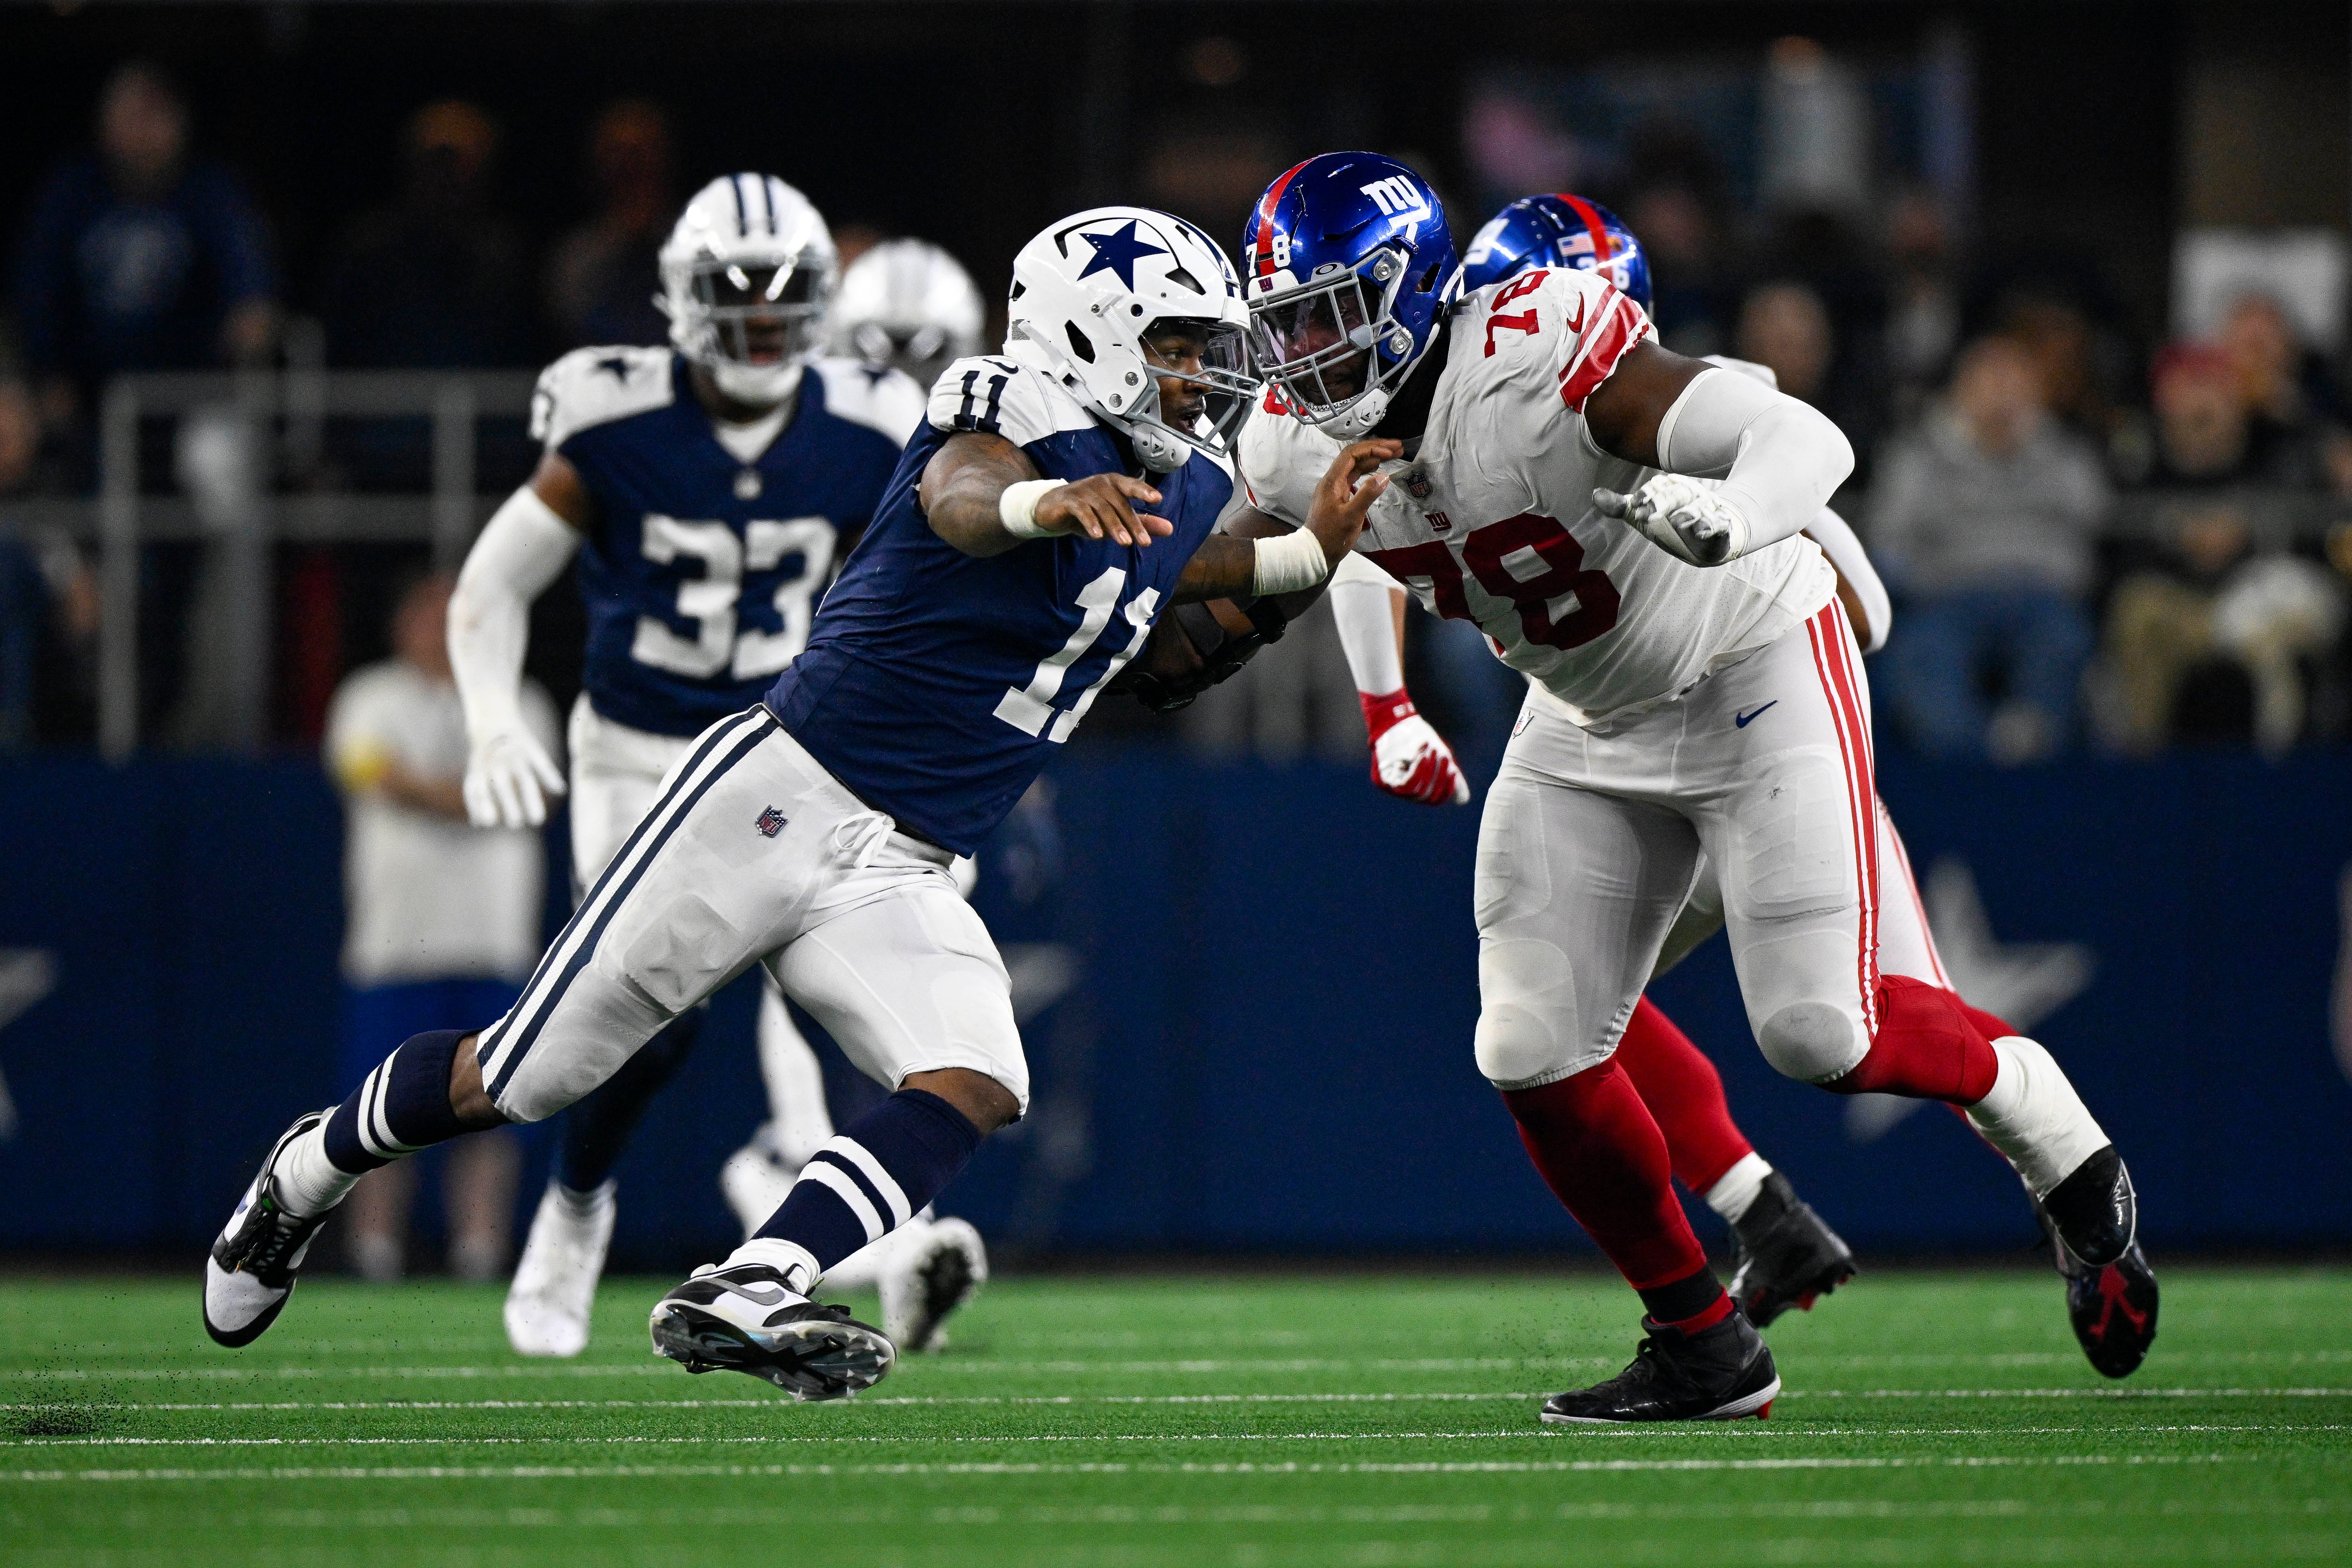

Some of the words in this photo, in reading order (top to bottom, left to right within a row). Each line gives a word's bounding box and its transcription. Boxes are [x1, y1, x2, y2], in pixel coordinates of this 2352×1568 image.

[1246, 234, 1291, 278] 78
[1484, 270, 1550, 358] 78
[954, 370, 1009, 433] 11
[629, 513, 838, 681] 33
[1360, 512, 1621, 651] 78
[992, 566, 1161, 744] 11
[759, 815, 780, 834] NFL
